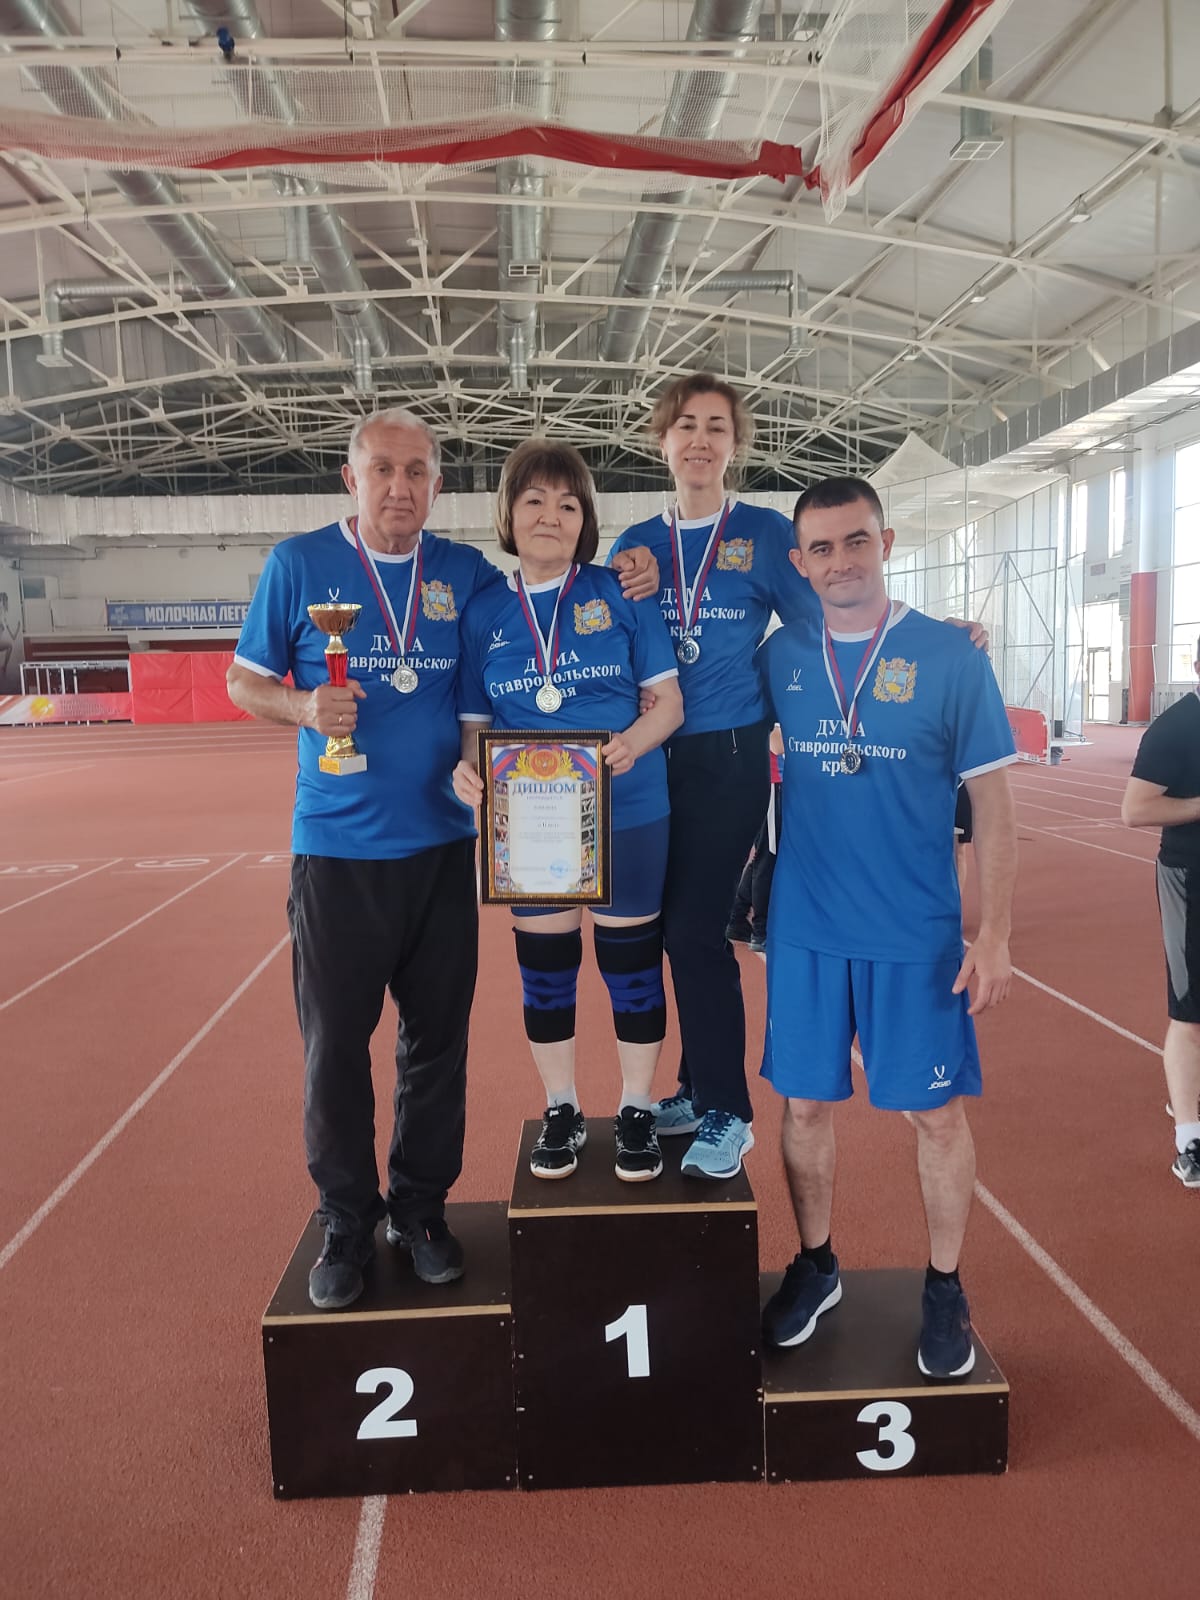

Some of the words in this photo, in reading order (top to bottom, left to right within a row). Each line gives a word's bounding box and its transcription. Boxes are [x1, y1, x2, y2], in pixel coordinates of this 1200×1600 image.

[144, 605, 217, 623] МОЛОЧНАЯ
[370, 634, 425, 654] ДУА
[524, 649, 581, 675] ДМА
[511, 783, 577, 796] ДИПЛОМ
[605, 1304, 651, 1378] 1
[355, 1367, 419, 1440] 2
[855, 1401, 916, 1472] 3
